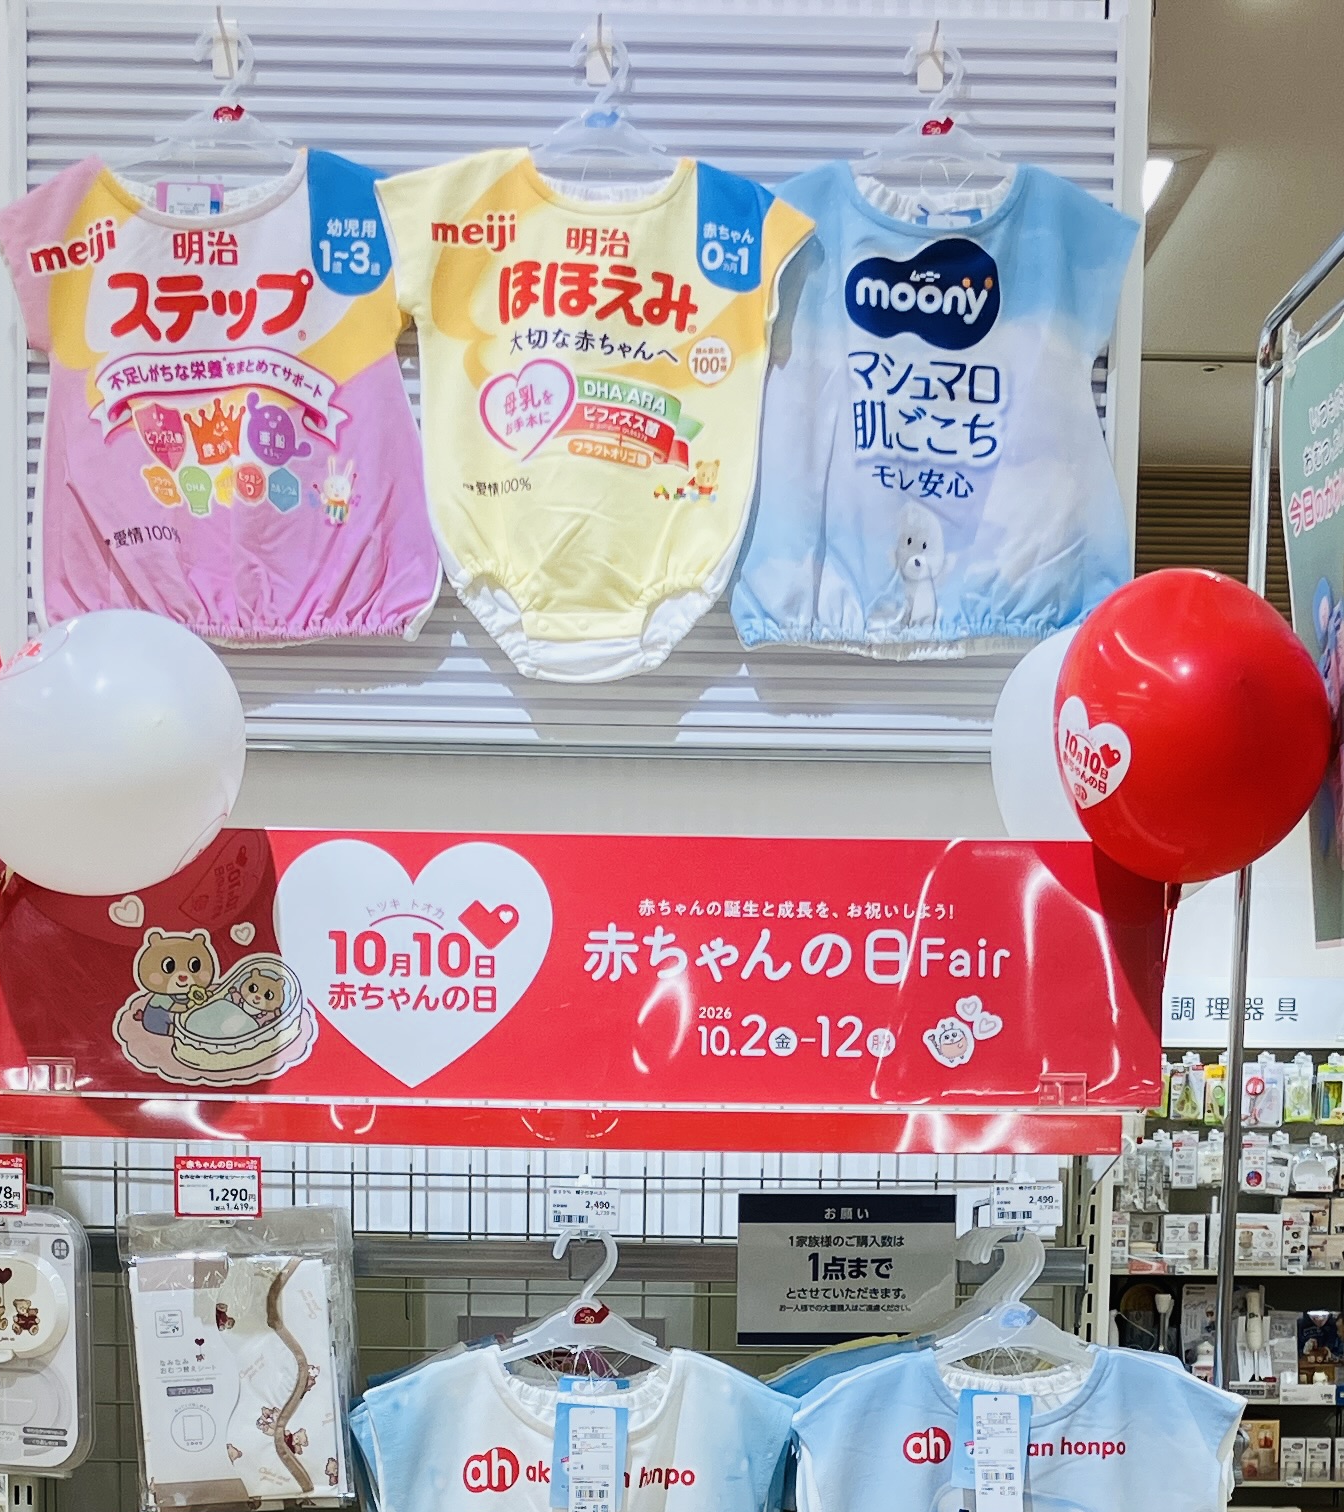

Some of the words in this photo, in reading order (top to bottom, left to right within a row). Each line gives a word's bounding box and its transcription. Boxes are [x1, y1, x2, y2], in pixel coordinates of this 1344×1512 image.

[327, 220, 376, 237] 幼児用
[432, 215, 516, 252] meiji
[567, 227, 630, 257] 明治
[704, 224, 754, 244] 赤ちゃん
[30, 219, 117, 274] meiji
[173, 232, 238, 266] 明治
[108, 269, 313, 342] ステップ
[499, 260, 697, 332] ほほえみ
[856, 277, 993, 325] moony
[510, 328, 679, 364] 大切な赤ちゃんへ
[849, 351, 1000, 404] マシュマロ
[504, 384, 553, 413] 母乳を
[506, 412, 551, 435] お手本に
[855, 400, 998, 459] 肌ごこち
[873, 466, 974, 498] モレ安心
[1065, 729, 1108, 780] 10月10日
[329, 931, 495, 978] 10月10日
[584, 922, 1010, 984] 赤ちゃんの日Fair
[329, 983, 496, 1012] 赤ちゃんの日
[698, 1006, 732, 1020] 2026
[209, 1188, 256, 1202] 1,290円
[824, 1208, 869, 1220] お願い
[788, 1235, 904, 1249] 1家族様のご購入数は
[807, 1252, 893, 1282] 1点まで
[786, 1287, 907, 1300] とさせていただきます。
[1061, 1437, 1126, 1458] honpo
